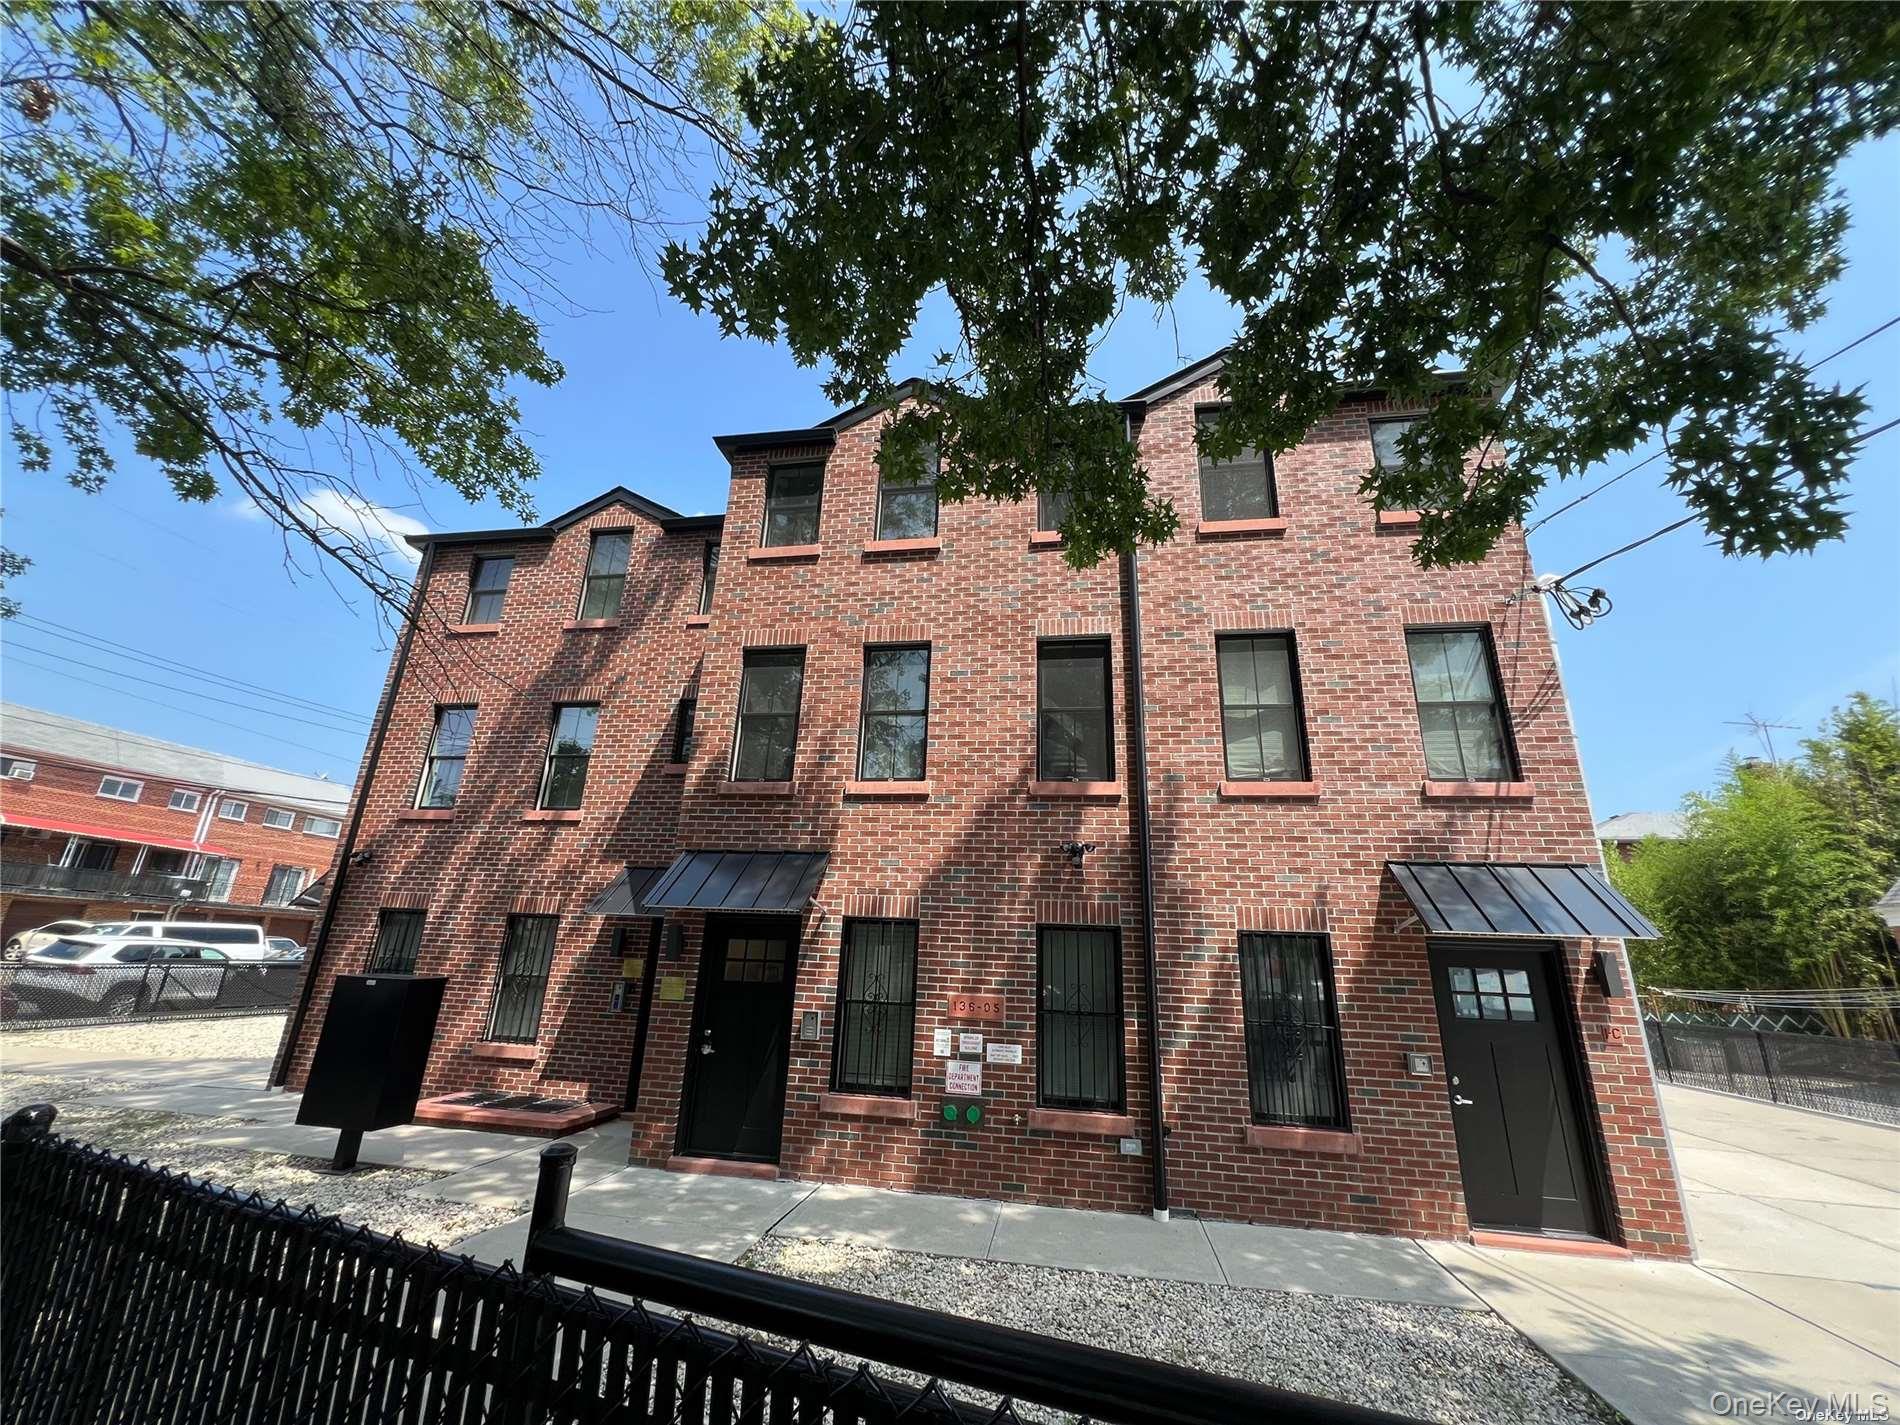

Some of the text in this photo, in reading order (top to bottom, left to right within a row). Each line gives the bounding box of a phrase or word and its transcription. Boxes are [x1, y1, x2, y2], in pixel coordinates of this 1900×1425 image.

[953, 1001, 1000, 1013] 136-05
[948, 1072, 979, 1081] DEPARTMENT
[949, 1082, 978, 1091] CONNECTION
